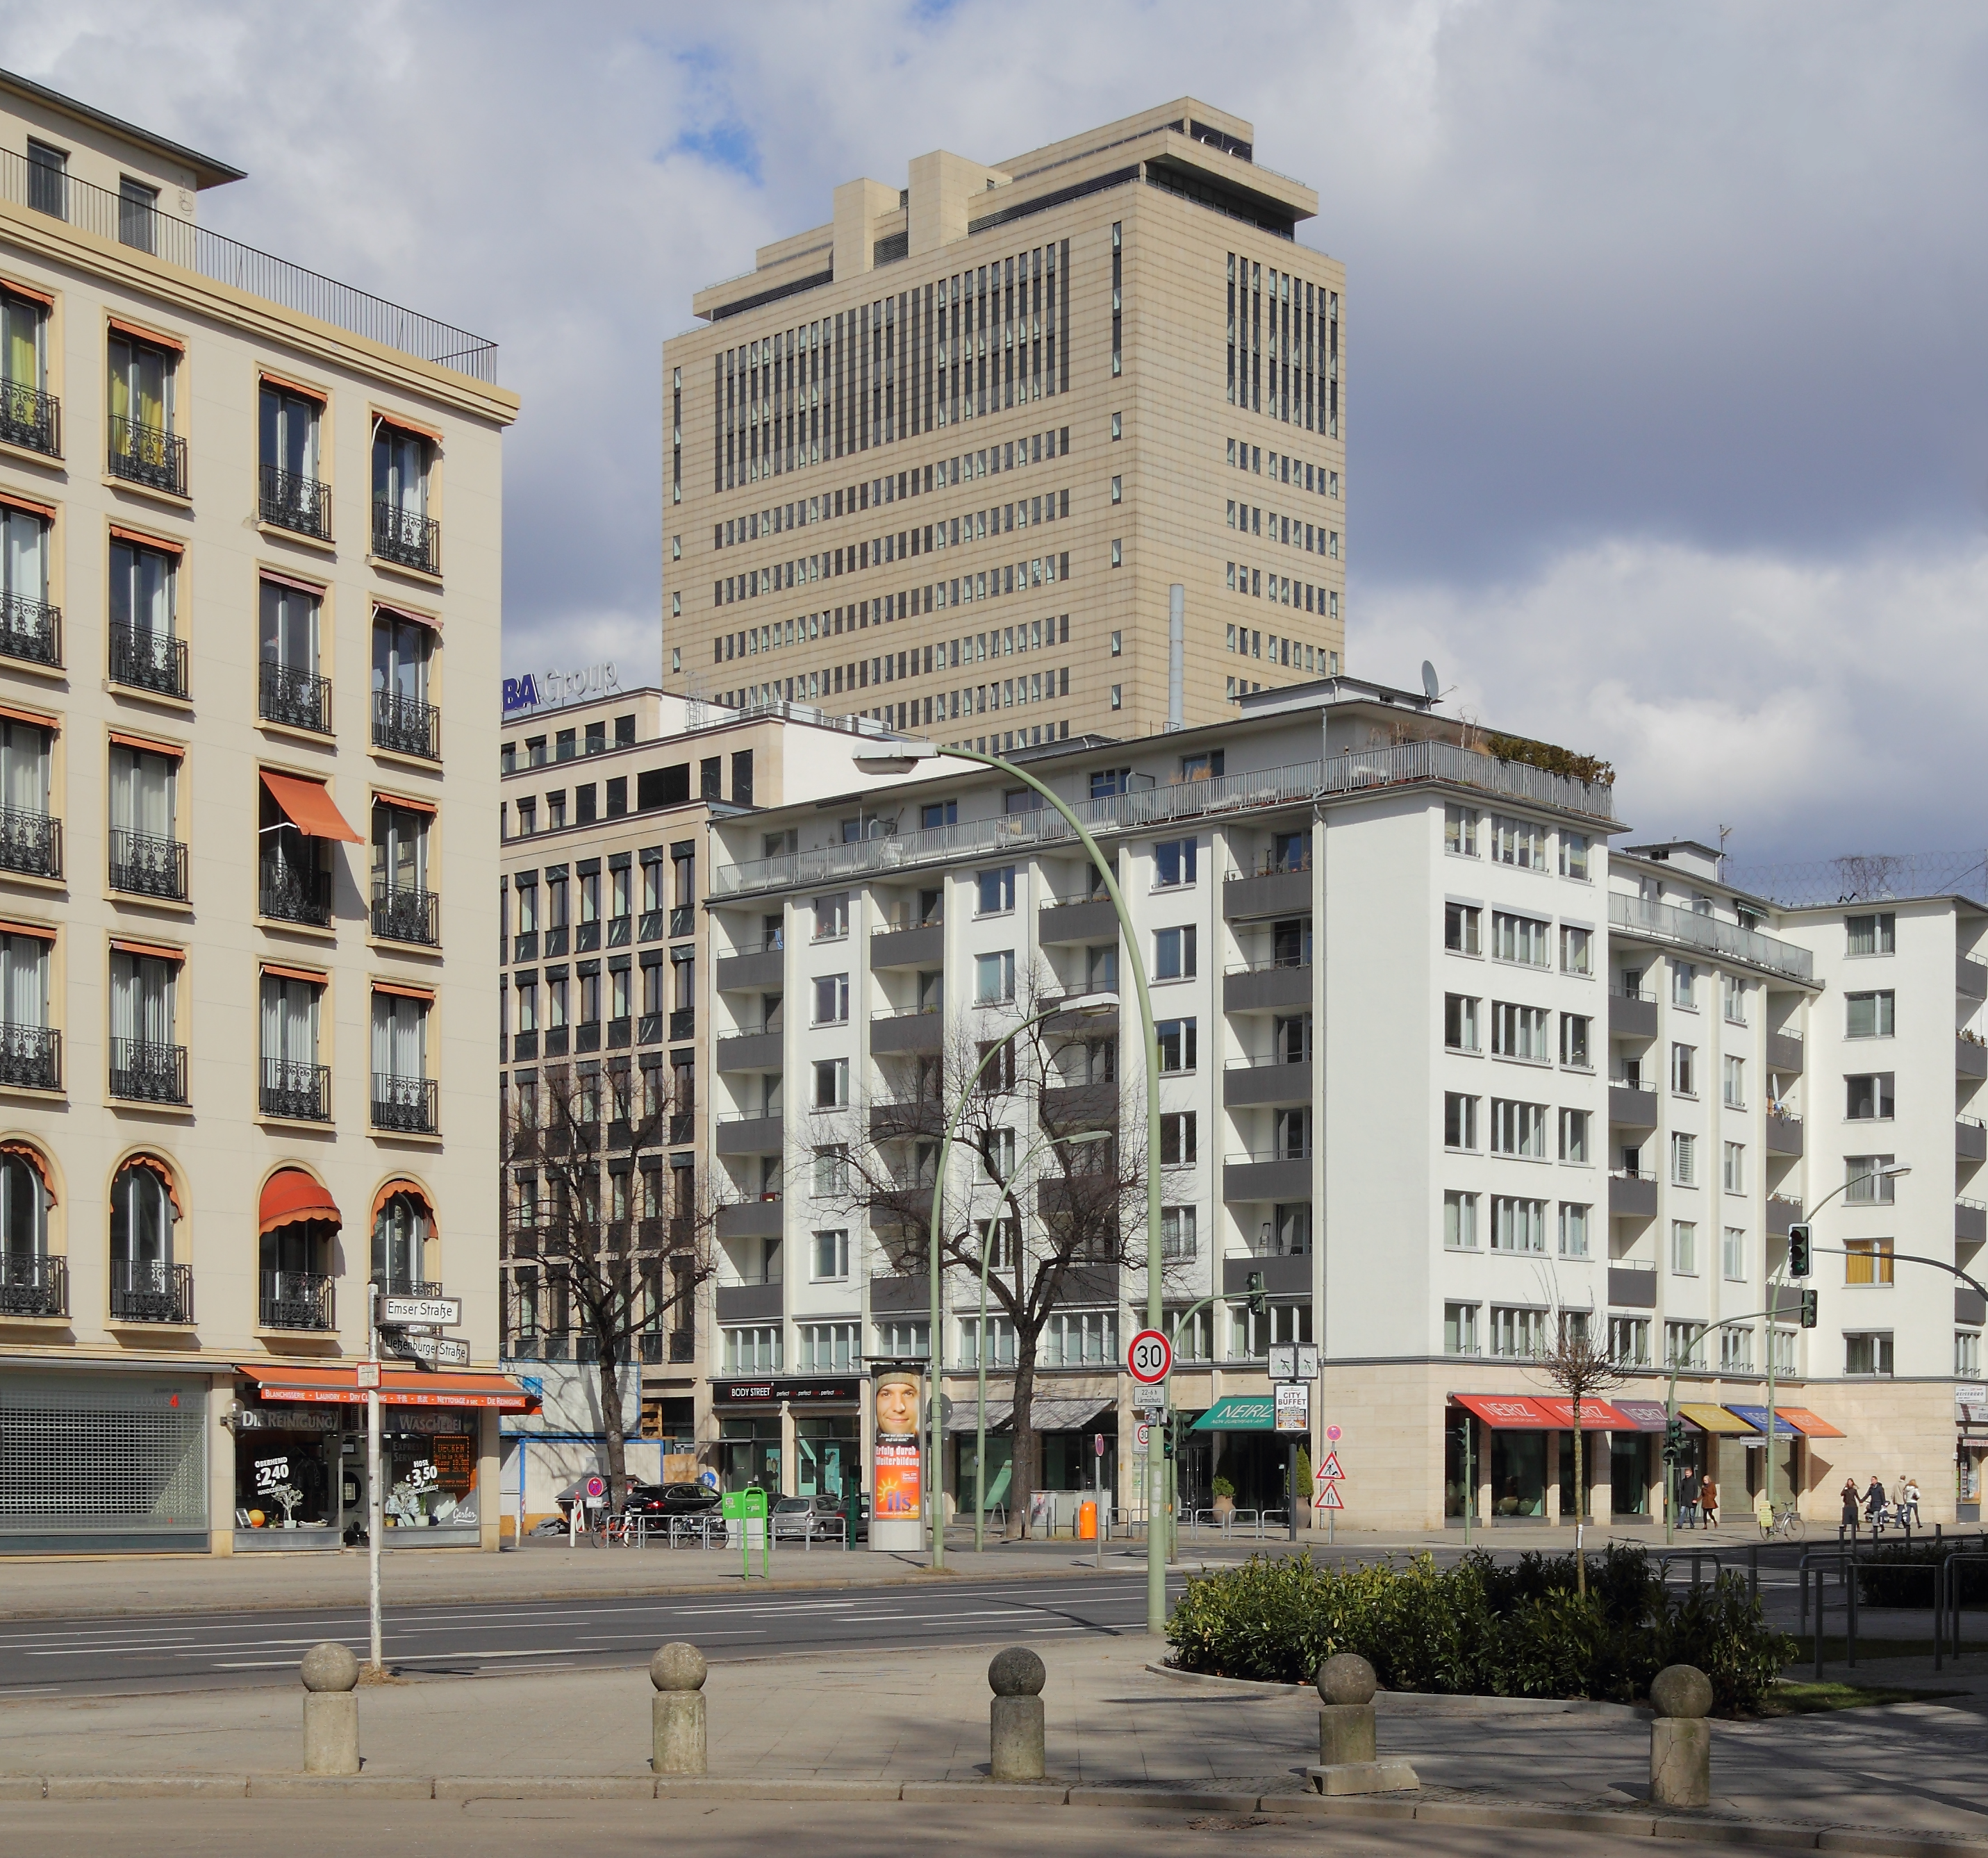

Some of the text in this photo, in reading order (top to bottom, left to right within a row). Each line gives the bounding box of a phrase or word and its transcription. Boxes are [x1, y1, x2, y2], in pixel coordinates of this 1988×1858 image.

[542, 661, 618, 703] Group
[388, 1301, 452, 1318] Emser Straße
[386, 1334, 465, 1361] Lietzenburger Straße
[1137, 1344, 1161, 1368] 30
[731, 1388, 749, 1397] BODY
[749, 1388, 770, 1396] STREET
[1217, 1404, 1274, 1418] NEIRIZ
[1479, 1403, 1536, 1416] NEIRIZ
[268, 1411, 333, 1428] REINIGUNG
[399, 1414, 461, 1431] WÄSCHEREI
[877, 1445, 916, 1456] Erfolg durch
[413, 1459, 429, 1468] HOSE
[876, 1457, 920, 1467] Weiterbildung
[260, 1464, 289, 1487] 2,40
[412, 1466, 438, 1487] 3,50
